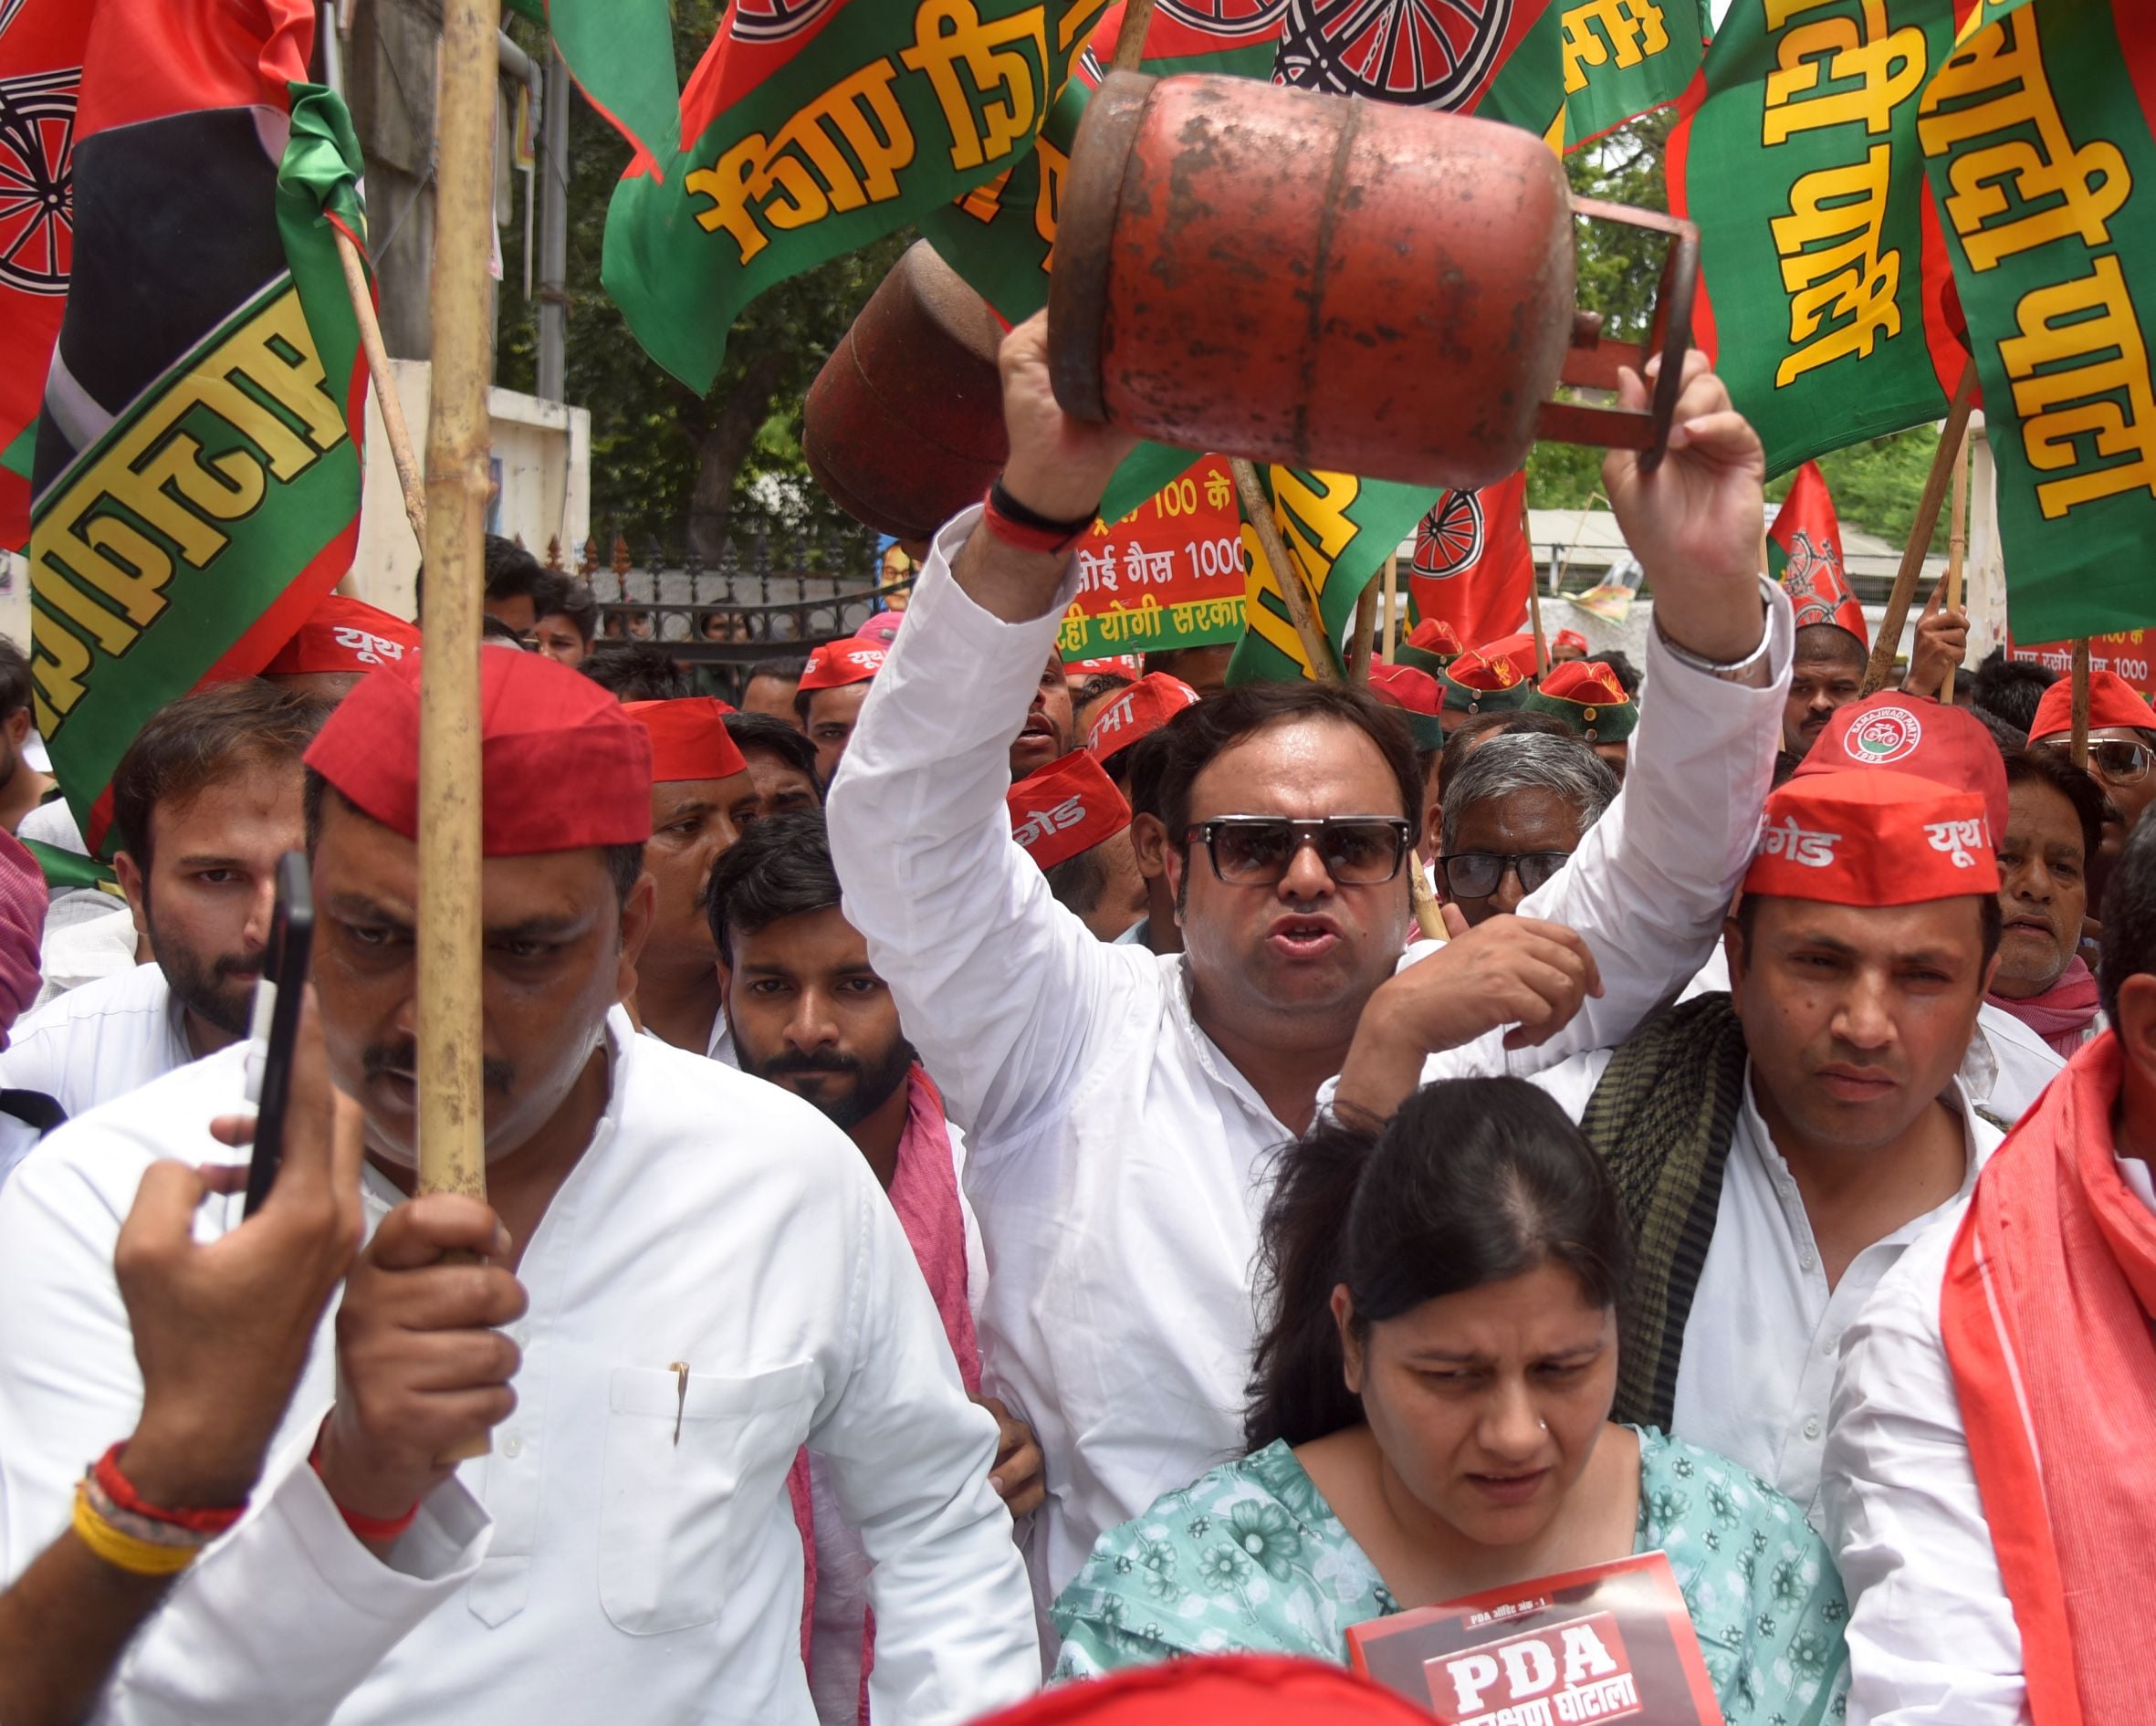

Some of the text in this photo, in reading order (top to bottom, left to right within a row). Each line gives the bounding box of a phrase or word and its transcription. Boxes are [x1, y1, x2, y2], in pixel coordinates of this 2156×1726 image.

[1204, 469, 1231, 511] के
[1124, 540, 1175, 584] गैस
[1096, 593, 1164, 643] योगी
[2113, 656, 2148, 681] 1000
[1470, 1611, 1492, 1625] PDA
[1446, 1623, 1617, 1715] PDA
[1553, 1671, 1638, 1722] घोटाला
